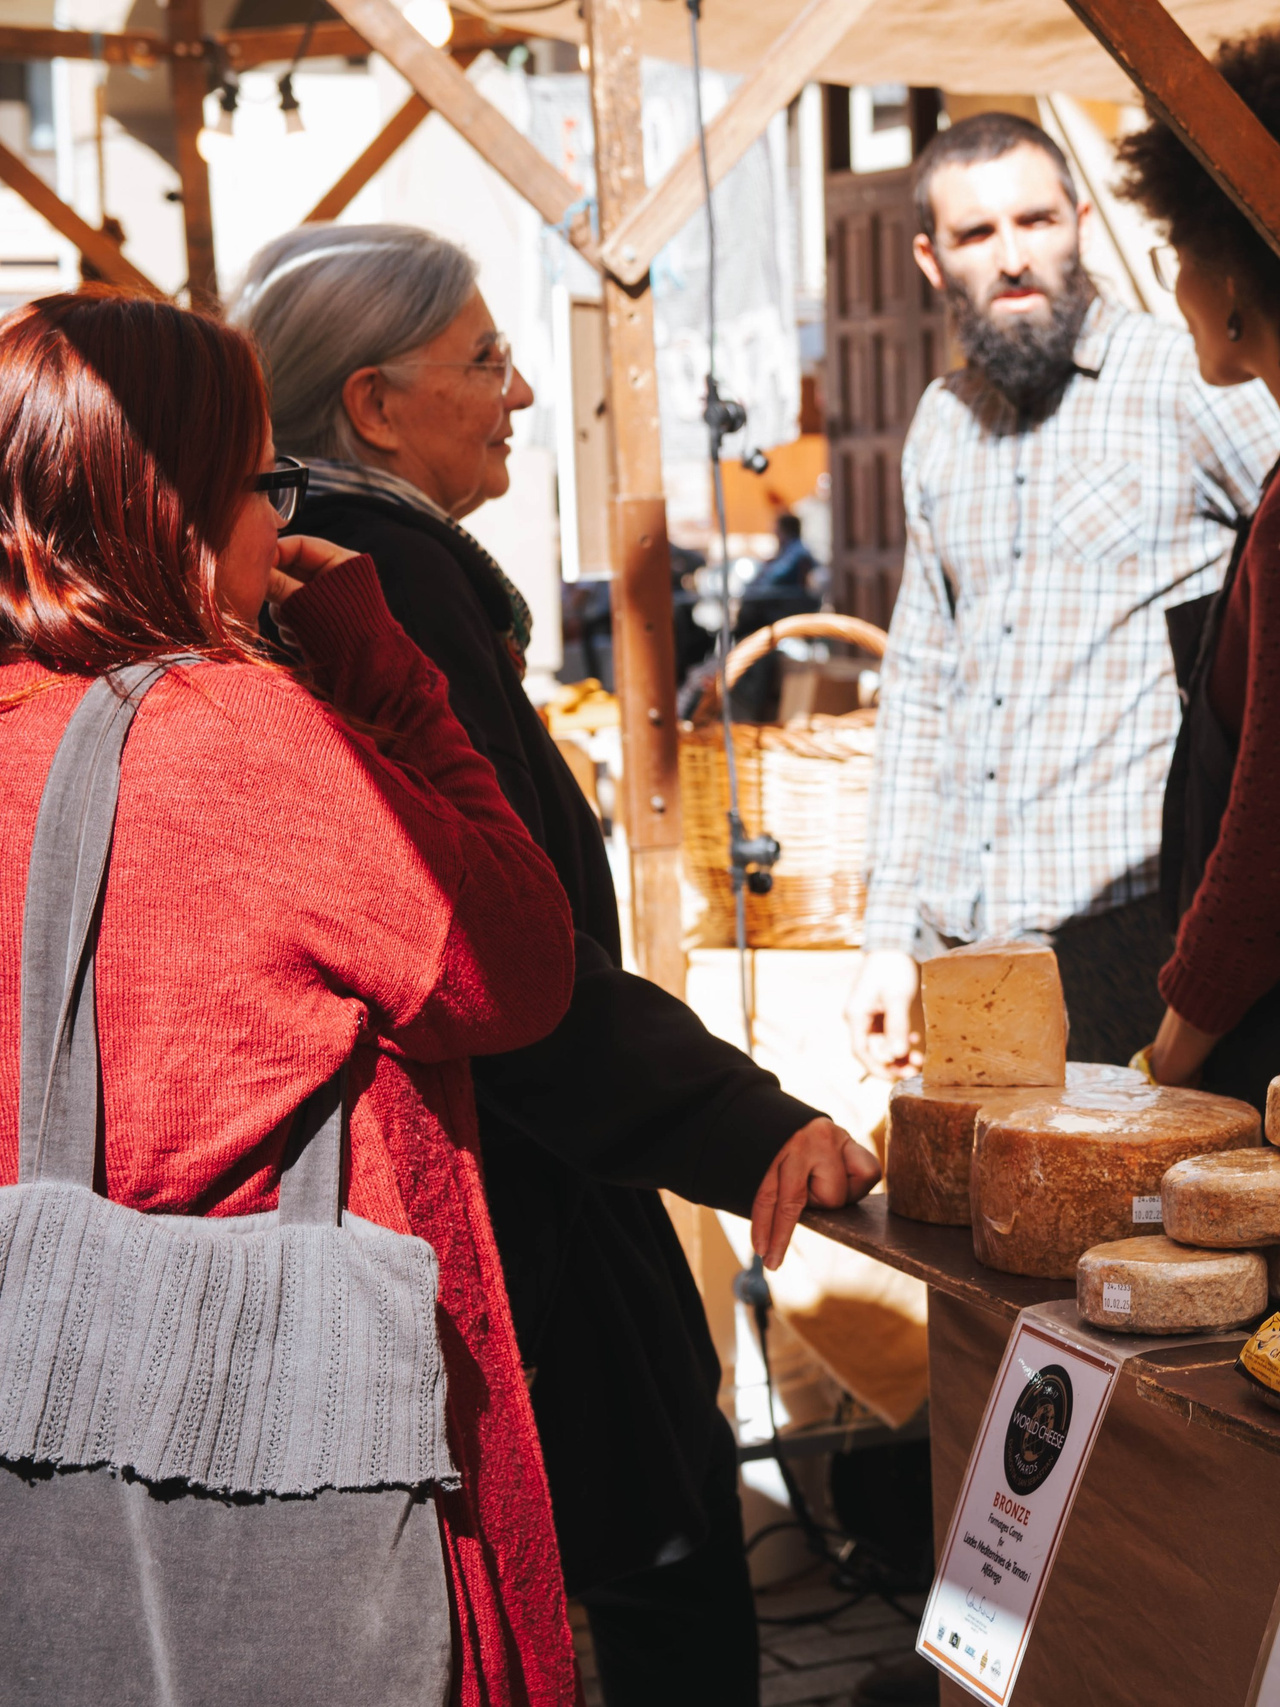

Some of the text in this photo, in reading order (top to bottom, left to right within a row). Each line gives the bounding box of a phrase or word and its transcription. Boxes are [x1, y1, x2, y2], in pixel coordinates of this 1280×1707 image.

[1104, 1298, 1130, 1310] 10.02.25
[1013, 1410, 1065, 1450] WORLD CHEESE
[1014, 1453, 1038, 1475] AWARDS
[993, 1491, 1031, 1526] BRONZE
[988, 1512, 1023, 1543] Formatges Camps
[997, 1536, 1005, 1547] for
[1004, 1558, 1011, 1571] de
